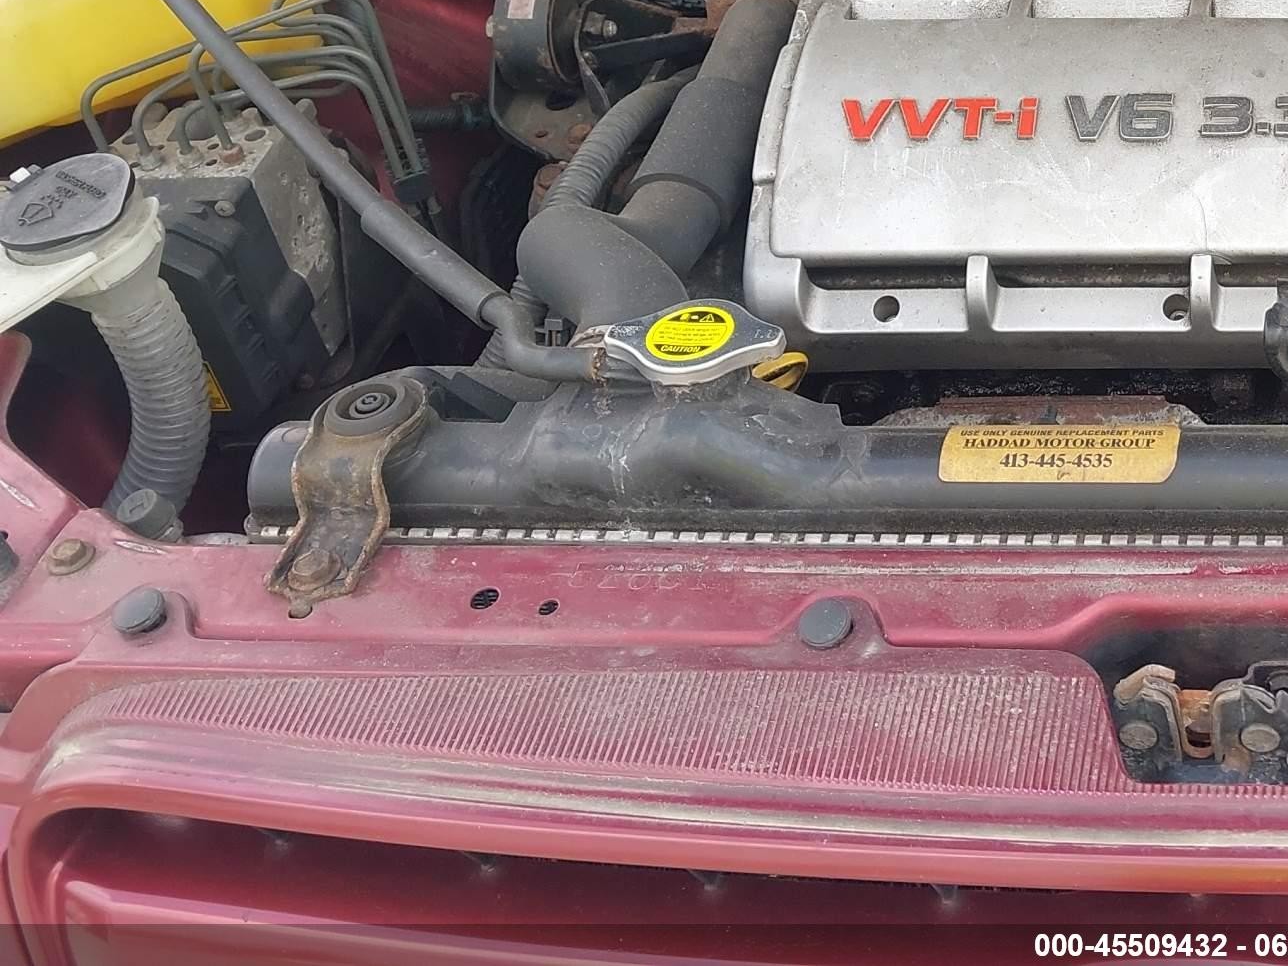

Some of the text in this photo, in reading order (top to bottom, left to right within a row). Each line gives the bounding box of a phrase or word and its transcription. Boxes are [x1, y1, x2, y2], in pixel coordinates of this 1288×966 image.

[841, 97, 1039, 140] VVT-i
[1064, 93, 1176, 141] V6
[660, 345, 700, 353] CAUTION
[964, 438, 1156, 449] HADDAD MOTOR GROUP
[1000, 453, 1113, 468] 413-445-4535
